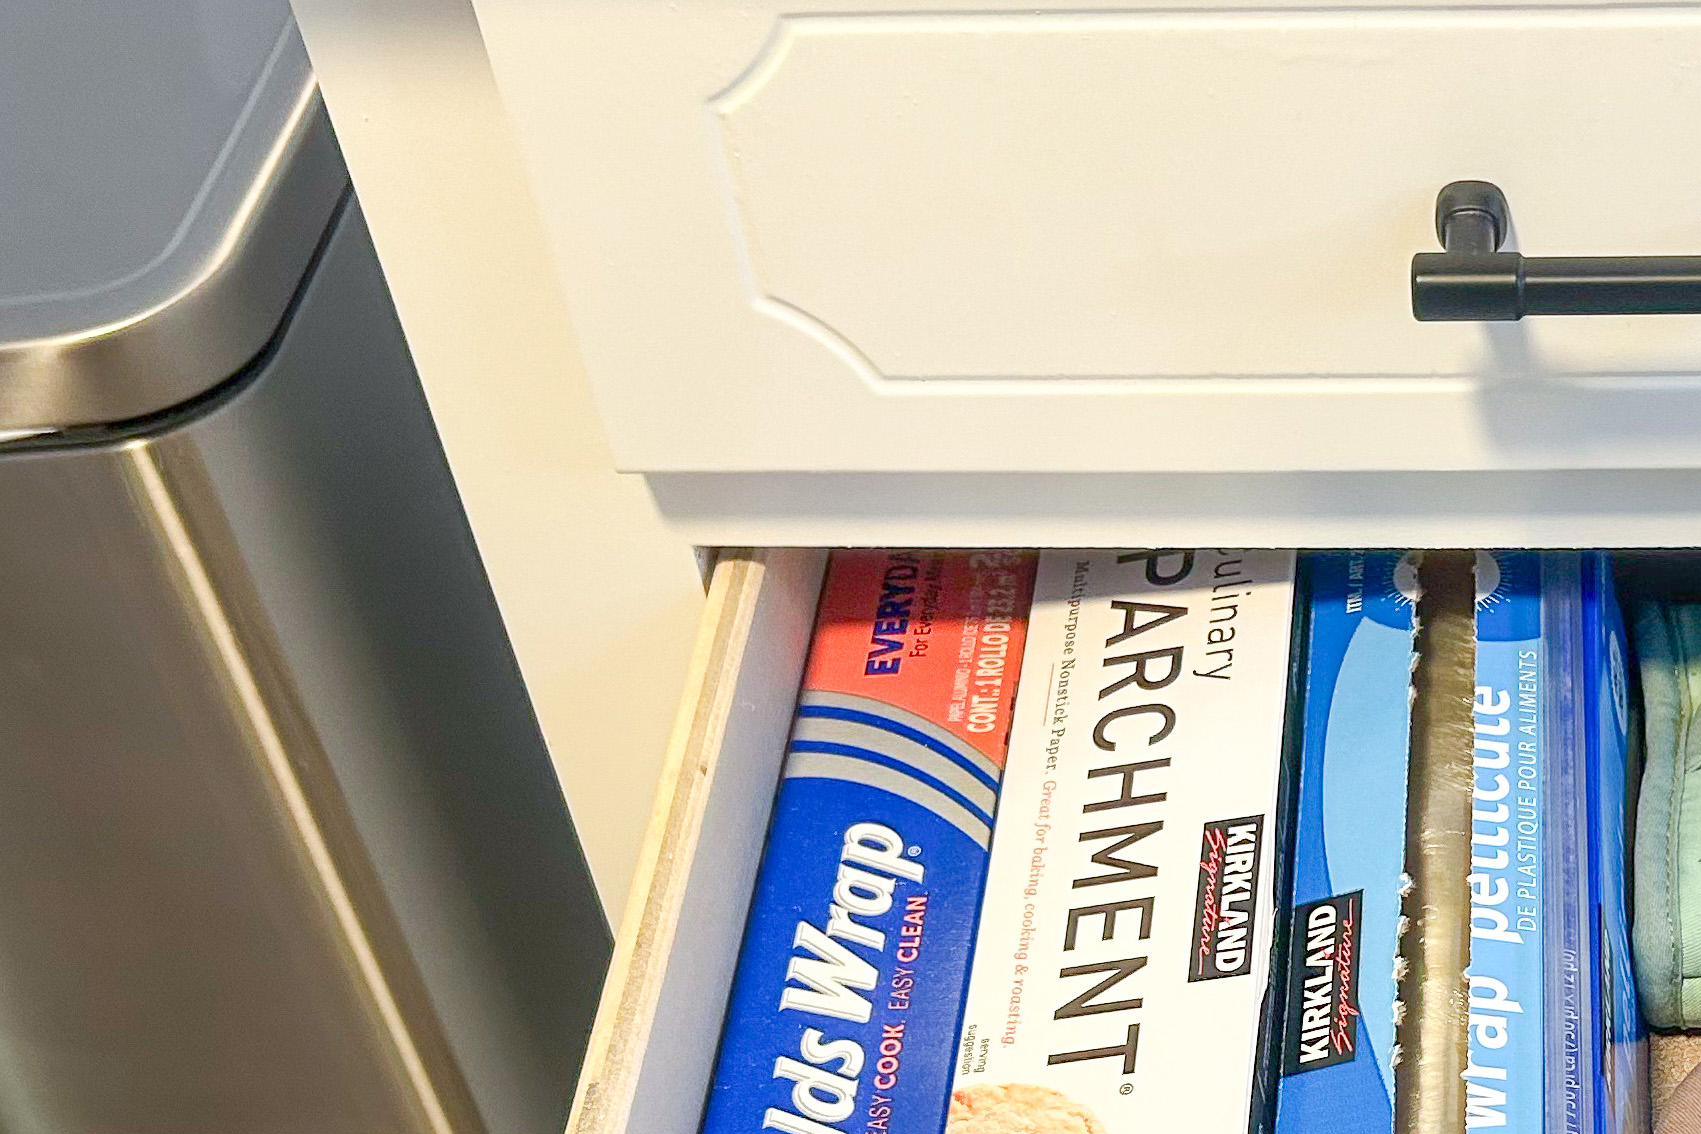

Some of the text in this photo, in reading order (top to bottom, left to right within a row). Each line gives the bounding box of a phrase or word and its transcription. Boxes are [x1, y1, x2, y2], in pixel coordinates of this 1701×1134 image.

[909, 638, 930, 657] For
[975, 634, 1010, 677] ROLLO
[1045, 560, 1091, 775] Multipurpose Nonstick Paper.
[1516, 649, 1539, 932] DE PLASTIQUE POUR ALIMENTS
[1001, 780, 1057, 1049] Great for baking, cooking & roasting.
[1199, 827, 1228, 976] Signature
[1214, 823, 1258, 974] KIRKLAND
[887, 967, 916, 1011] EASY
[961, 1023, 978, 1076] suggestion
[1299, 903, 1338, 1065] KIRKLAND
[1329, 897, 1360, 1056] Signature
[1464, 974, 1524, 1130] wrap
[973, 1037, 991, 1074] serving
